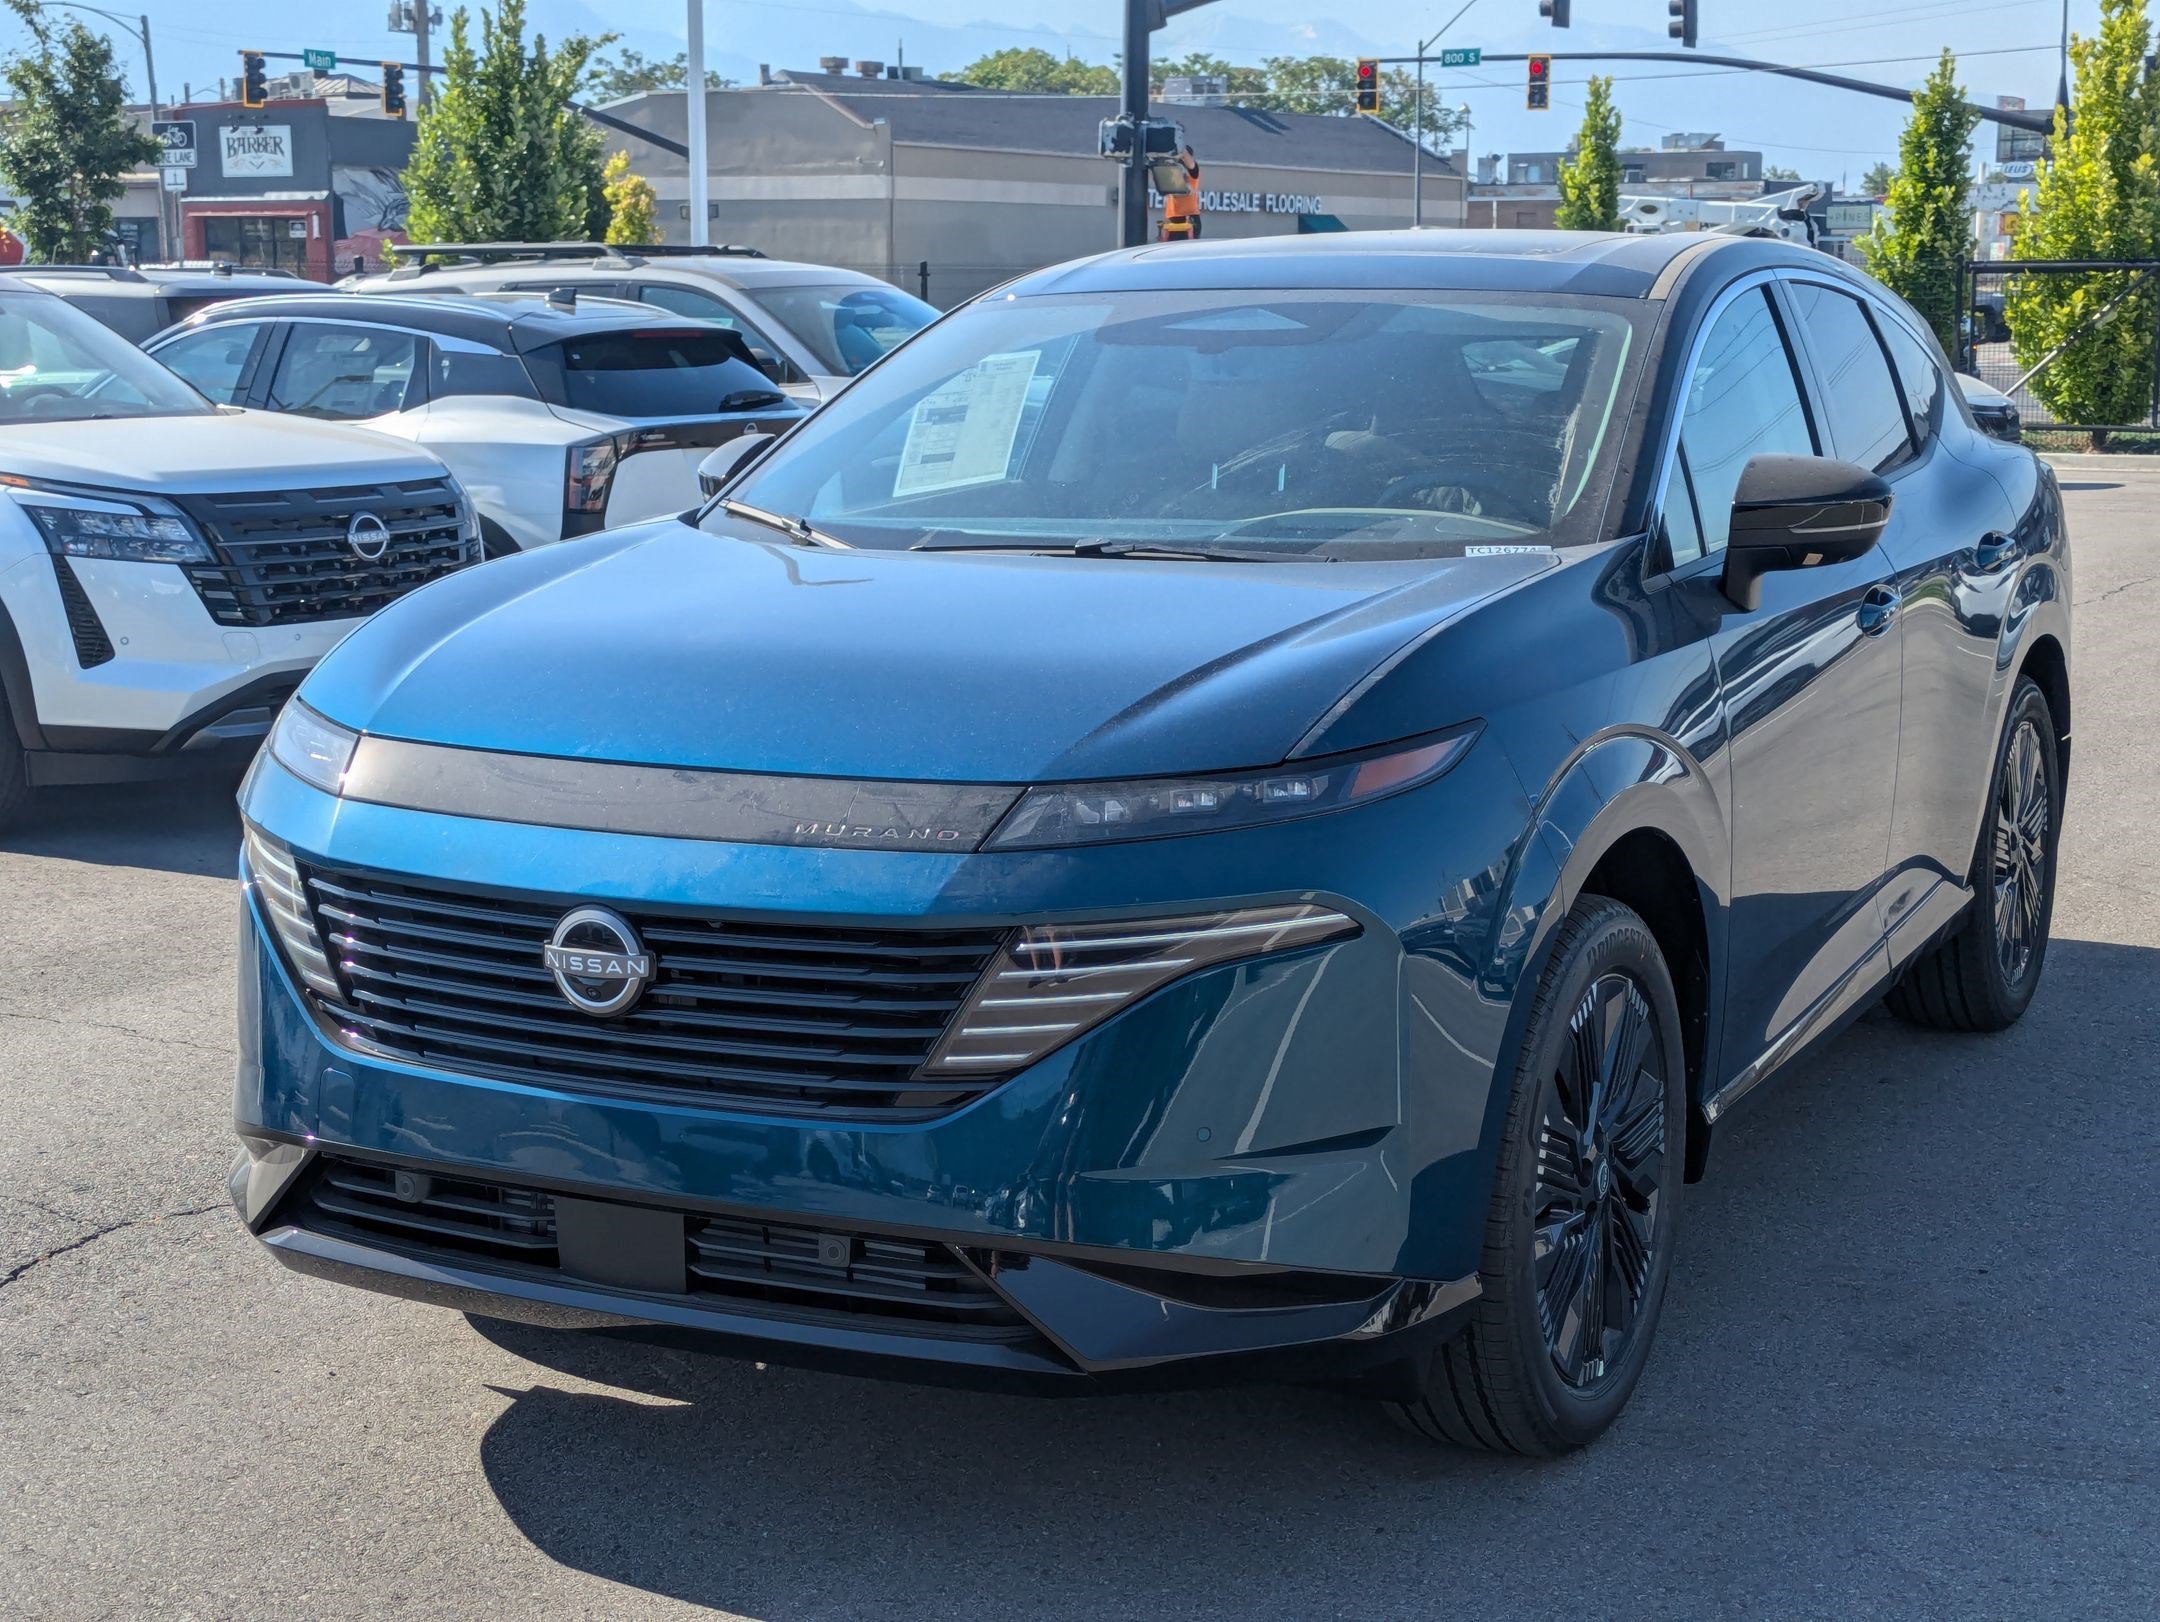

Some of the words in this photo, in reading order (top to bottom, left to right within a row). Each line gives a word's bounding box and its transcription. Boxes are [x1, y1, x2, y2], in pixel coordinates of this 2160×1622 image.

[308, 52, 331, 67] Main
[1469, 53, 1475, 63] S
[226, 136, 284, 158] BARBER
[175, 151, 194, 163] LANE
[1198, 191, 1260, 212] HOLESALE
[1266, 195, 1322, 214] FLOORING
[352, 532, 388, 542] NISSAN
[795, 823, 959, 841] MURANO
[547, 951, 645, 974] NISSAN
